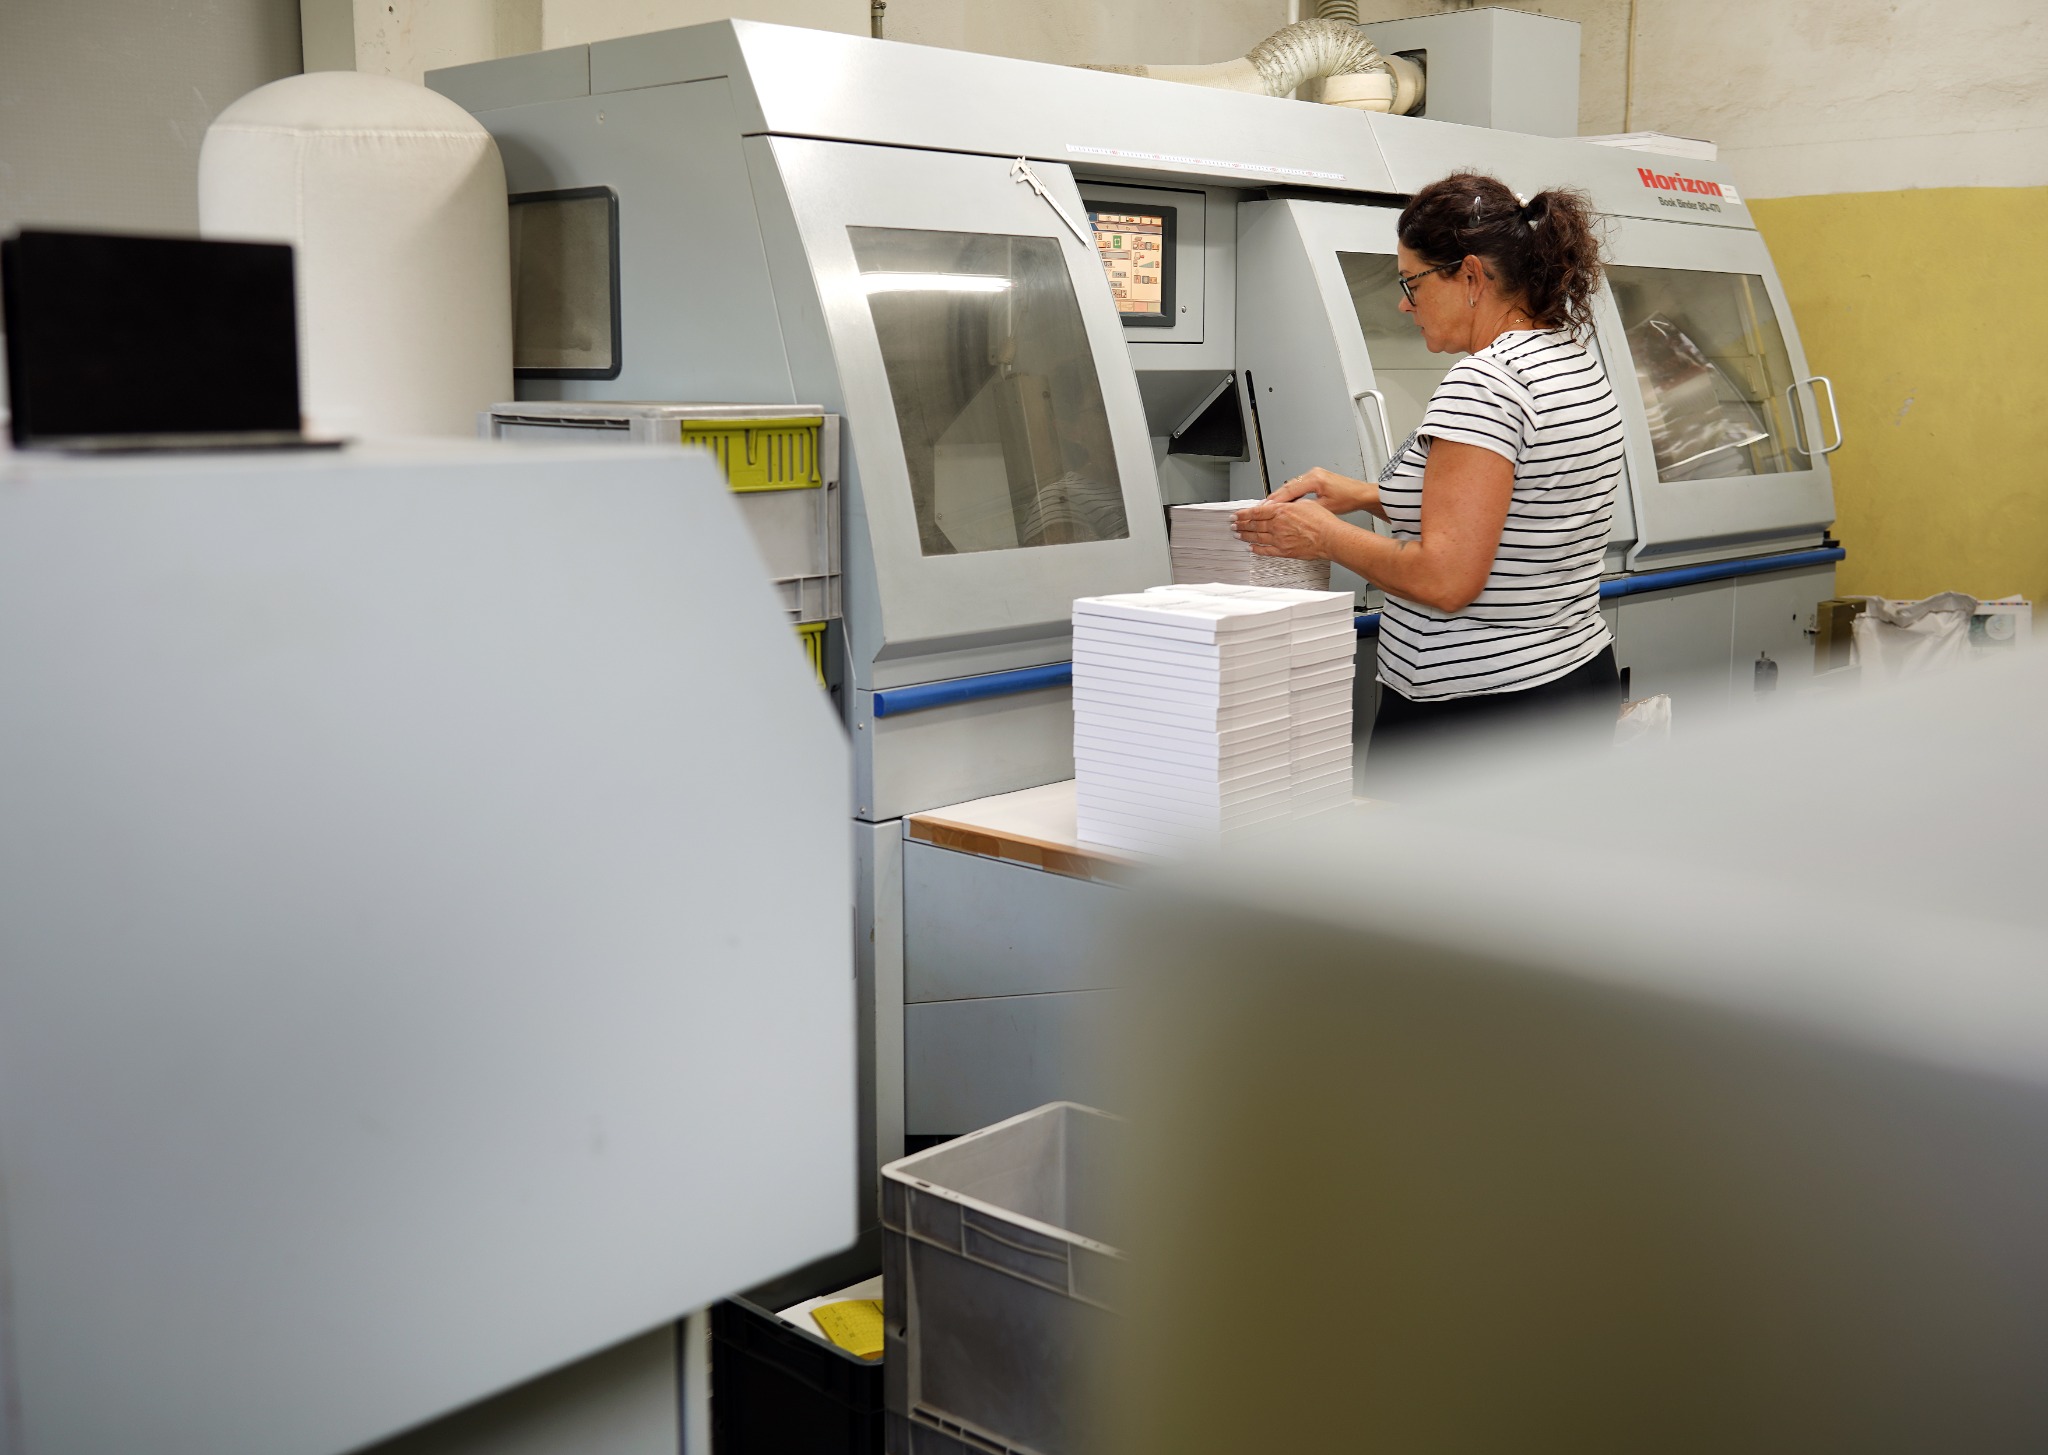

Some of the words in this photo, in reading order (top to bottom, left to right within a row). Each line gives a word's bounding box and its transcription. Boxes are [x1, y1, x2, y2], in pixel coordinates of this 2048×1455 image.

[1637, 168, 1723, 197] Horizon
[1658, 196, 1678, 207] Book
[1676, 199, 1698, 210] Binder
